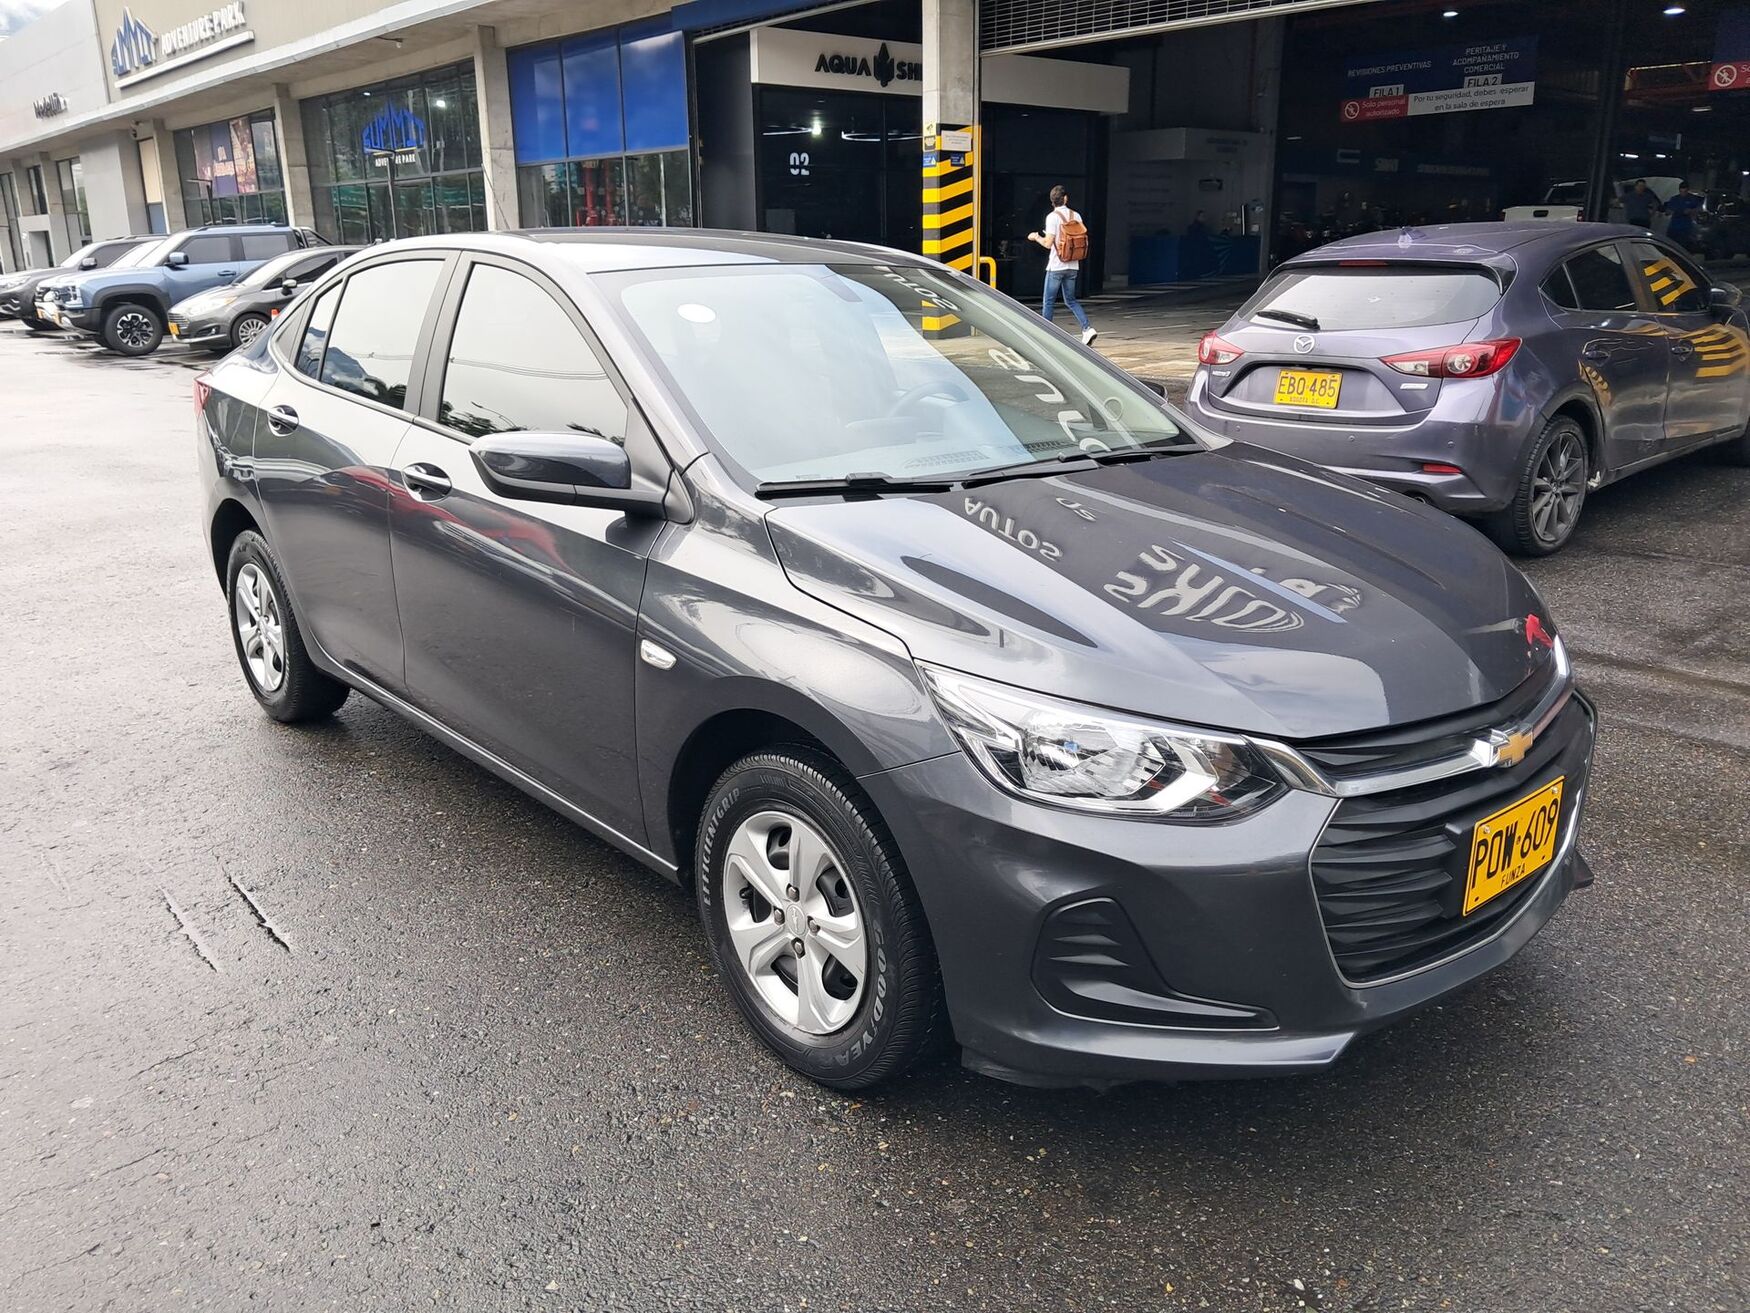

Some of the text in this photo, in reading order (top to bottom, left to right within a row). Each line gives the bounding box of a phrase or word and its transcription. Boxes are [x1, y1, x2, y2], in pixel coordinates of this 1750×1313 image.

[212, 1, 246, 34] PARK
[815, 54, 872, 77] AQUA
[1463, 63, 1505, 74] COMERCIAL
[1467, 76, 1498, 88] FILA 2
[1373, 87, 1394, 97] FILA
[1413, 95, 1425, 103] Por
[1473, 88, 1497, 99] debes
[789, 152, 810, 175] 02
[1500, 862, 1526, 888] FUNZA
